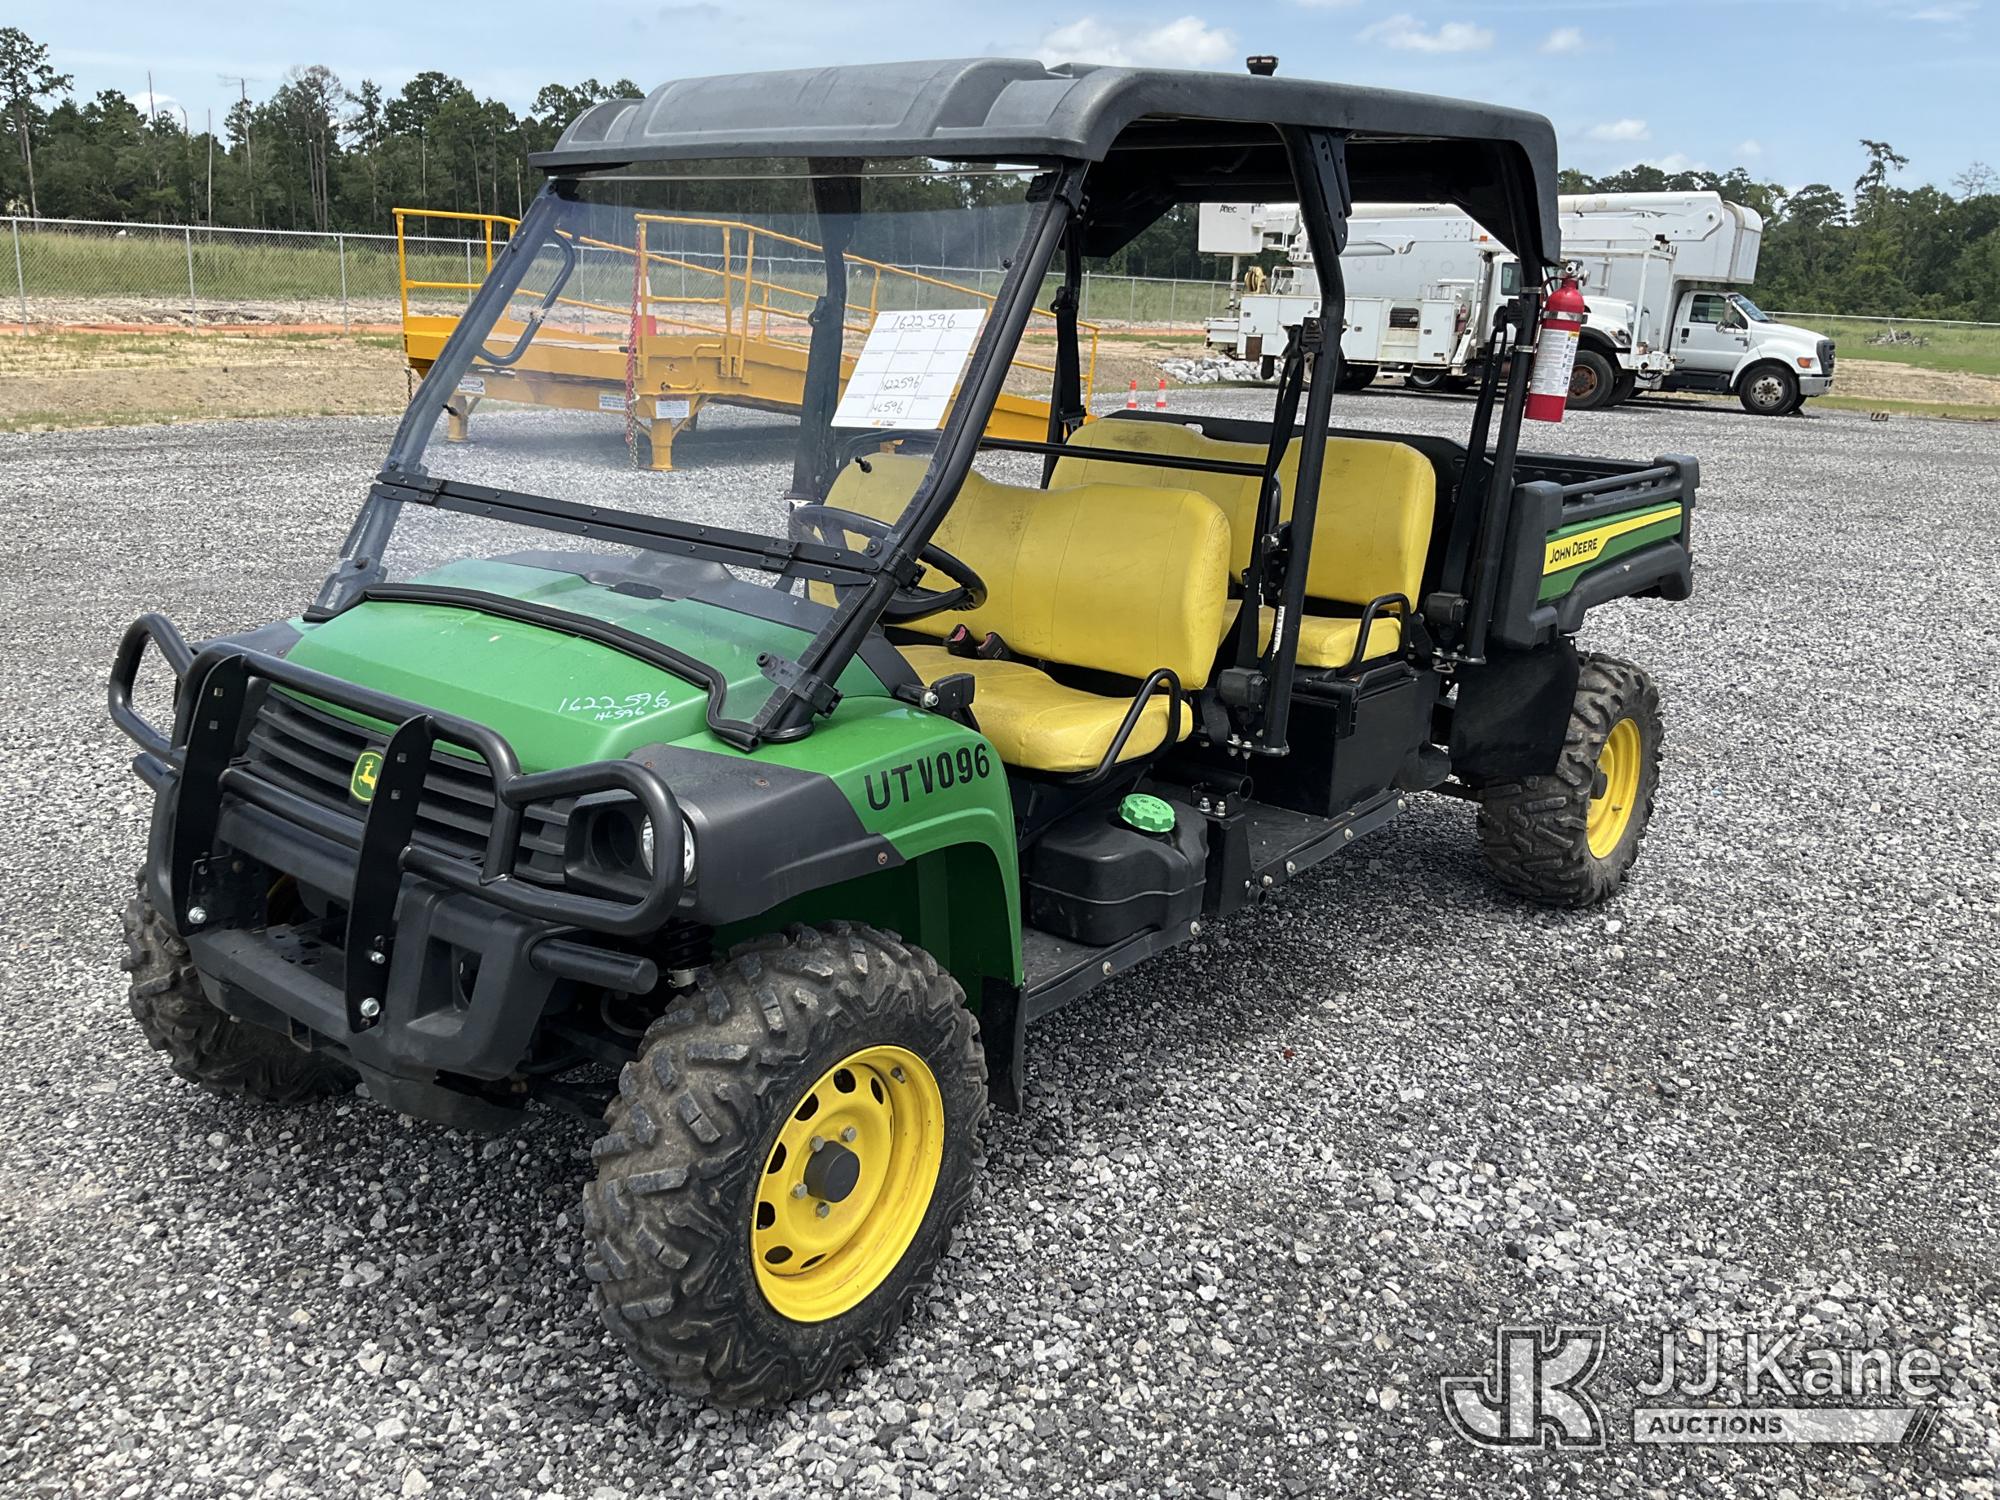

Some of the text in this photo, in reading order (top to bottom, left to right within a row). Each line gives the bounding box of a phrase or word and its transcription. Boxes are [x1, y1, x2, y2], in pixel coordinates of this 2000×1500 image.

[891, 313, 956, 330] 1622596
[1549, 537, 1598, 564] JOHN DEERE
[558, 690, 669, 713] 1622596
[863, 742, 990, 811] UTV096
